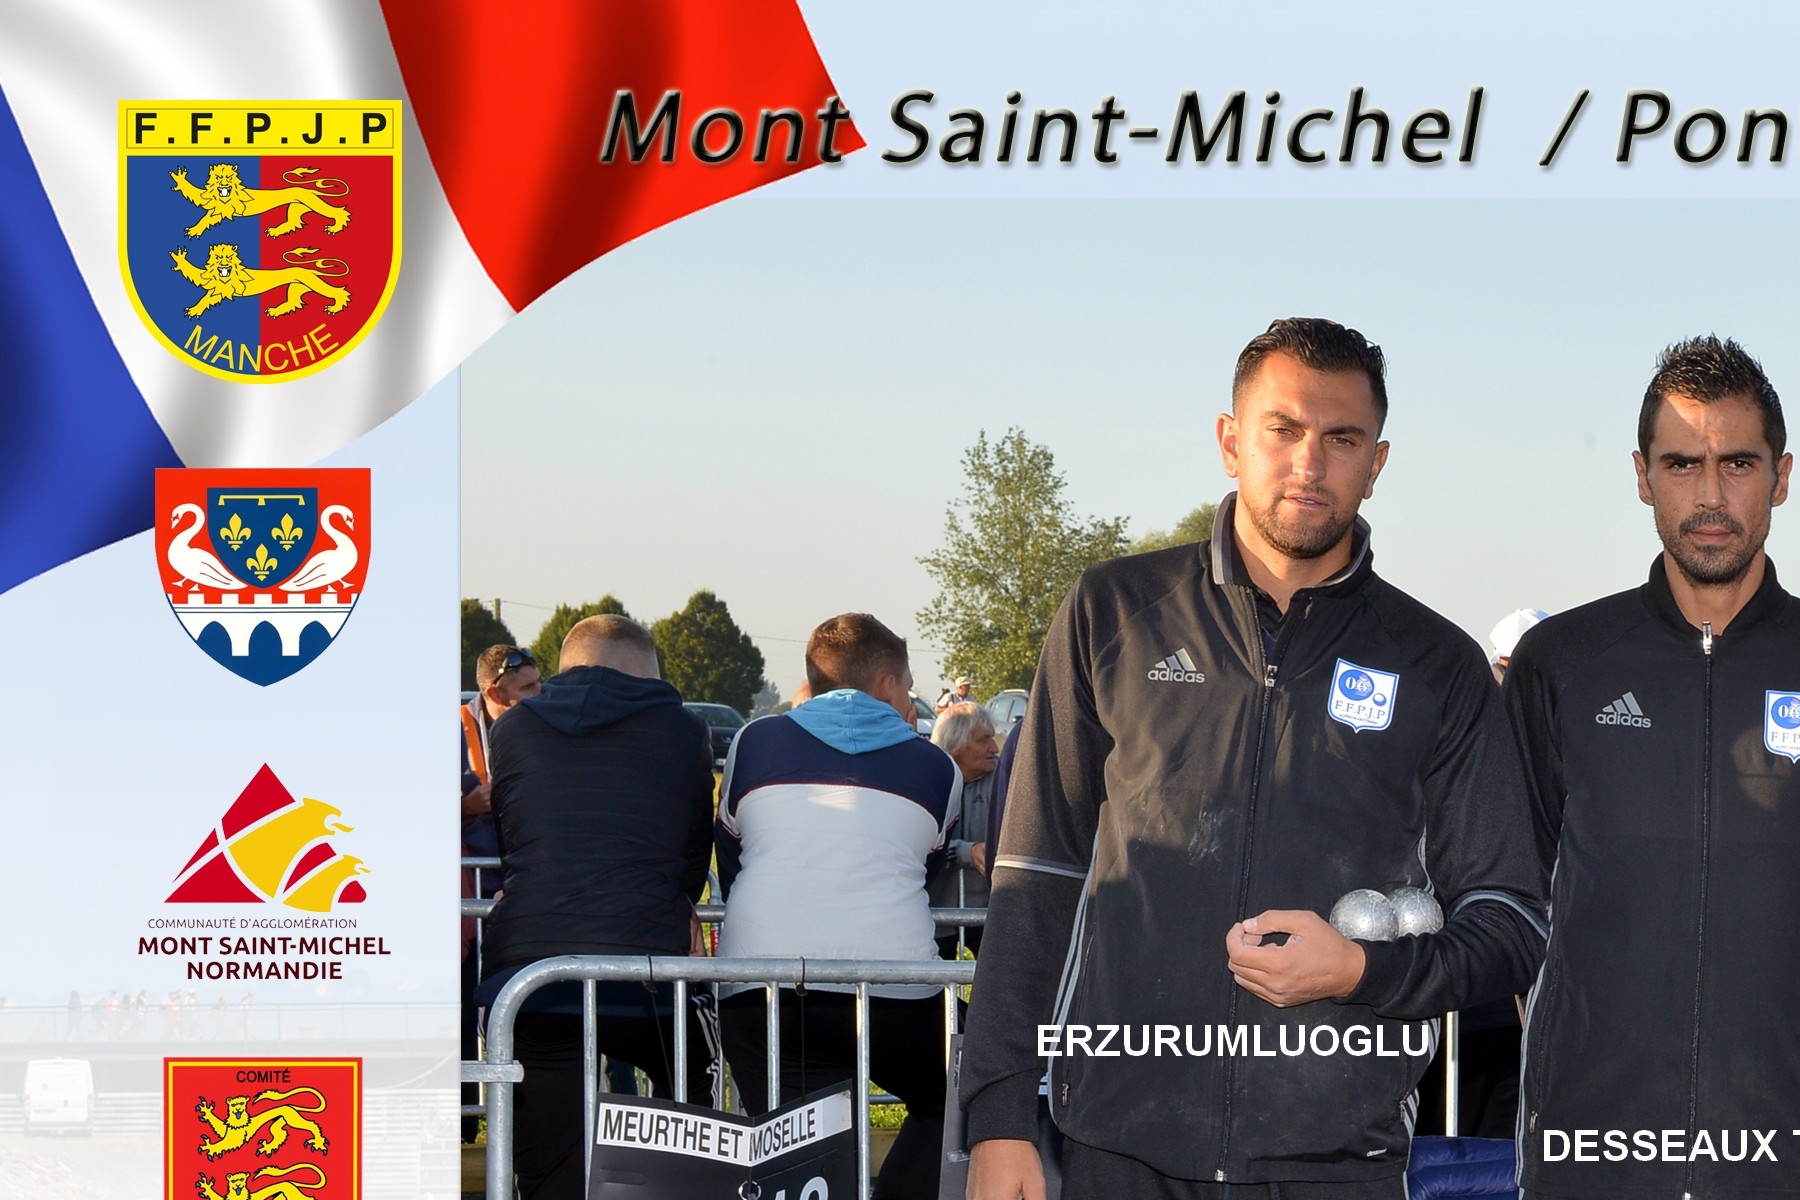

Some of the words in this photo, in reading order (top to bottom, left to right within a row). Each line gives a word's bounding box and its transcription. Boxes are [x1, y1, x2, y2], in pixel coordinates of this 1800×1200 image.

[1147, 667, 1206, 684] adidas
[1594, 711, 1652, 729] adidas
[602, 1108, 711, 1154] MEURTHE
[716, 1126, 744, 1160] ET
[748, 1107, 817, 1162] MOSELLE
